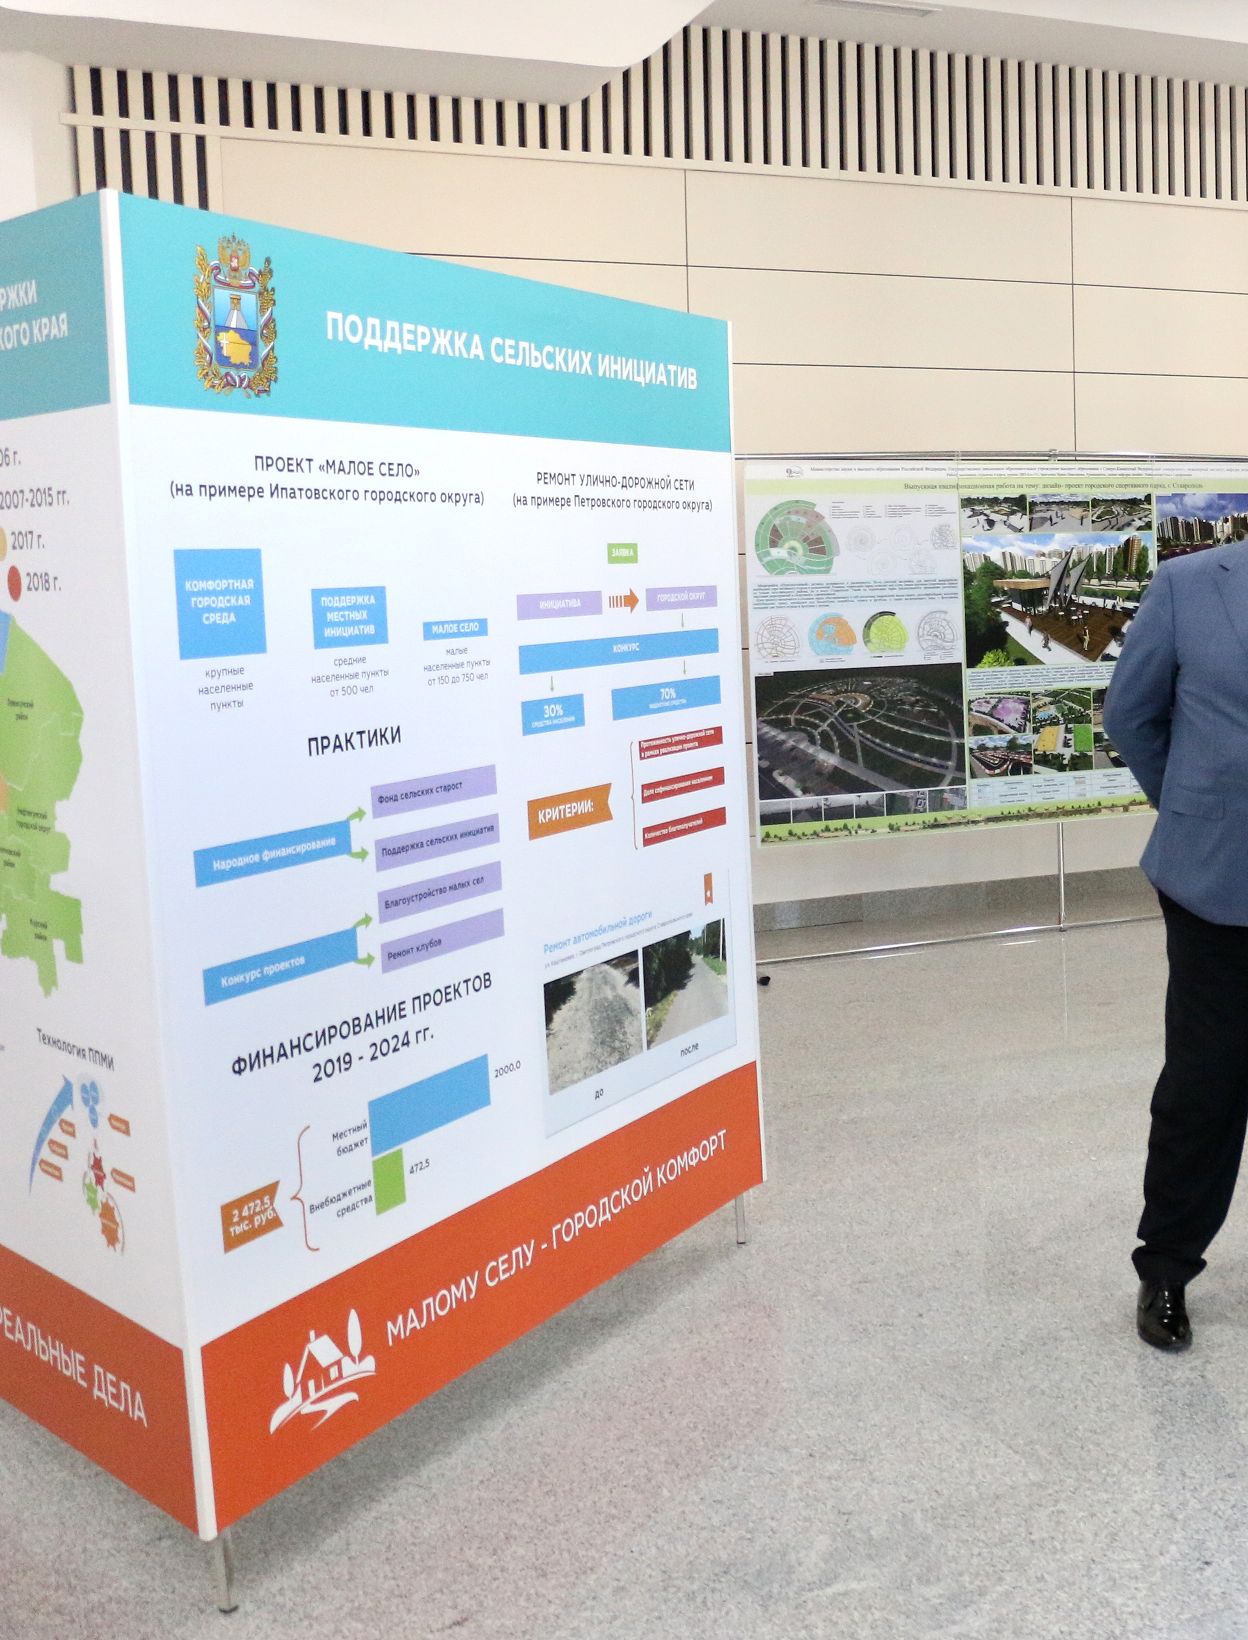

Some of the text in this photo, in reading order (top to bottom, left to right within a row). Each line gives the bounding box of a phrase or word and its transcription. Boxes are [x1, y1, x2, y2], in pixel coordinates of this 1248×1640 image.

[32, 312, 69, 344] КРАЯ
[325, 310, 698, 390] ПОДДЕРЖКА СЕЛЬСКИХ ИНИЦИАТИВ
[13, 450, 21, 466] г.
[254, 454, 420, 478] ПРОЕКТ «МАЛОЕ СЕЛО»
[536, 471, 695, 491] РЕМОНТ УЛИЧНО-ДОРОЖНОЙ СЕТИ
[0, 487, 54, 510] 2007-2015
[169, 479, 485, 507] (на примере Ипатовского городского округа)
[513, 493, 713, 512] (на примере Петровского городского округа)
[11, 530, 45, 551] 2017 г.
[611, 548, 634, 558] ЗАЯВКА
[26, 572, 62, 592] 2018 г.
[185, 578, 255, 592] КОМФОРТНАЯ
[191, 595, 251, 609] ГОРОДСКАЯ
[321, 594, 376, 608] ПОДДЕРЖКА
[539, 598, 581, 610] ИНИЦИАТИВА
[202, 612, 237, 625] СРЕДА
[326, 610, 368, 623] МЕСТНЫХ
[324, 624, 376, 638] ИНИЦИАТИВ
[431, 622, 480, 635] МАЛОЕ СЕЛО
[445, 646, 468, 657] малые
[613, 642, 640, 653] КОНКУРС
[333, 655, 367, 668] средние
[423, 658, 491, 672] населенные пункты
[204, 665, 245, 680] крупные
[311, 668, 389, 684] населенные пункты
[437, 675, 450, 686] 150
[198, 681, 254, 696] населенные
[330, 684, 374, 697] от 500 чел
[660, 687, 676, 700] 70%
[210, 699, 244, 713] пункты
[543, 704, 563, 718] 30%
[307, 725, 402, 757] ПРАКТИКИ
[378, 781, 463, 804] Фонд сельских старост
[538, 798, 594, 825] КРИТЕРИИ:
[381, 824, 495, 860] Поддержка сельских инициатив
[213, 836, 336, 872] Народное финансирование
[384, 876, 484, 910] Благоустройство малых сел
[387, 937, 442, 962] Ремонт клубов
[221, 956, 305, 989] Конкурс проектов
[231, 971, 492, 1077] ФИНАНСИРОВАНИЕ ПРОЕКТОВ
[36, 1027, 115, 1072] Технология ППМИ
[312, 1052, 353, 1084] 2019
[369, 1030, 411, 1062] 2024
[415, 1025, 435, 1045] гг.
[494, 1059, 522, 1079] 2000,0
[332, 1119, 368, 1143] Местный
[336, 1137, 368, 1158] бюджет
[409, 1158, 430, 1176] 472,5
[309, 1178, 372, 1214] Внебюджетные
[232, 1209, 240, 1223] 2
[336, 1195, 373, 1219] средства
[230, 1208, 278, 1238] тыс. руб.
[386, 1270, 480, 1347] МАЛОМУ
[485, 1239, 535, 1287] СЕЛУ
[551, 1165, 654, 1250] ГОРОДСКОЙ
[656, 1128, 727, 1188] КОМФОРТ
[93, 1363, 148, 1428] ДЕЛА
